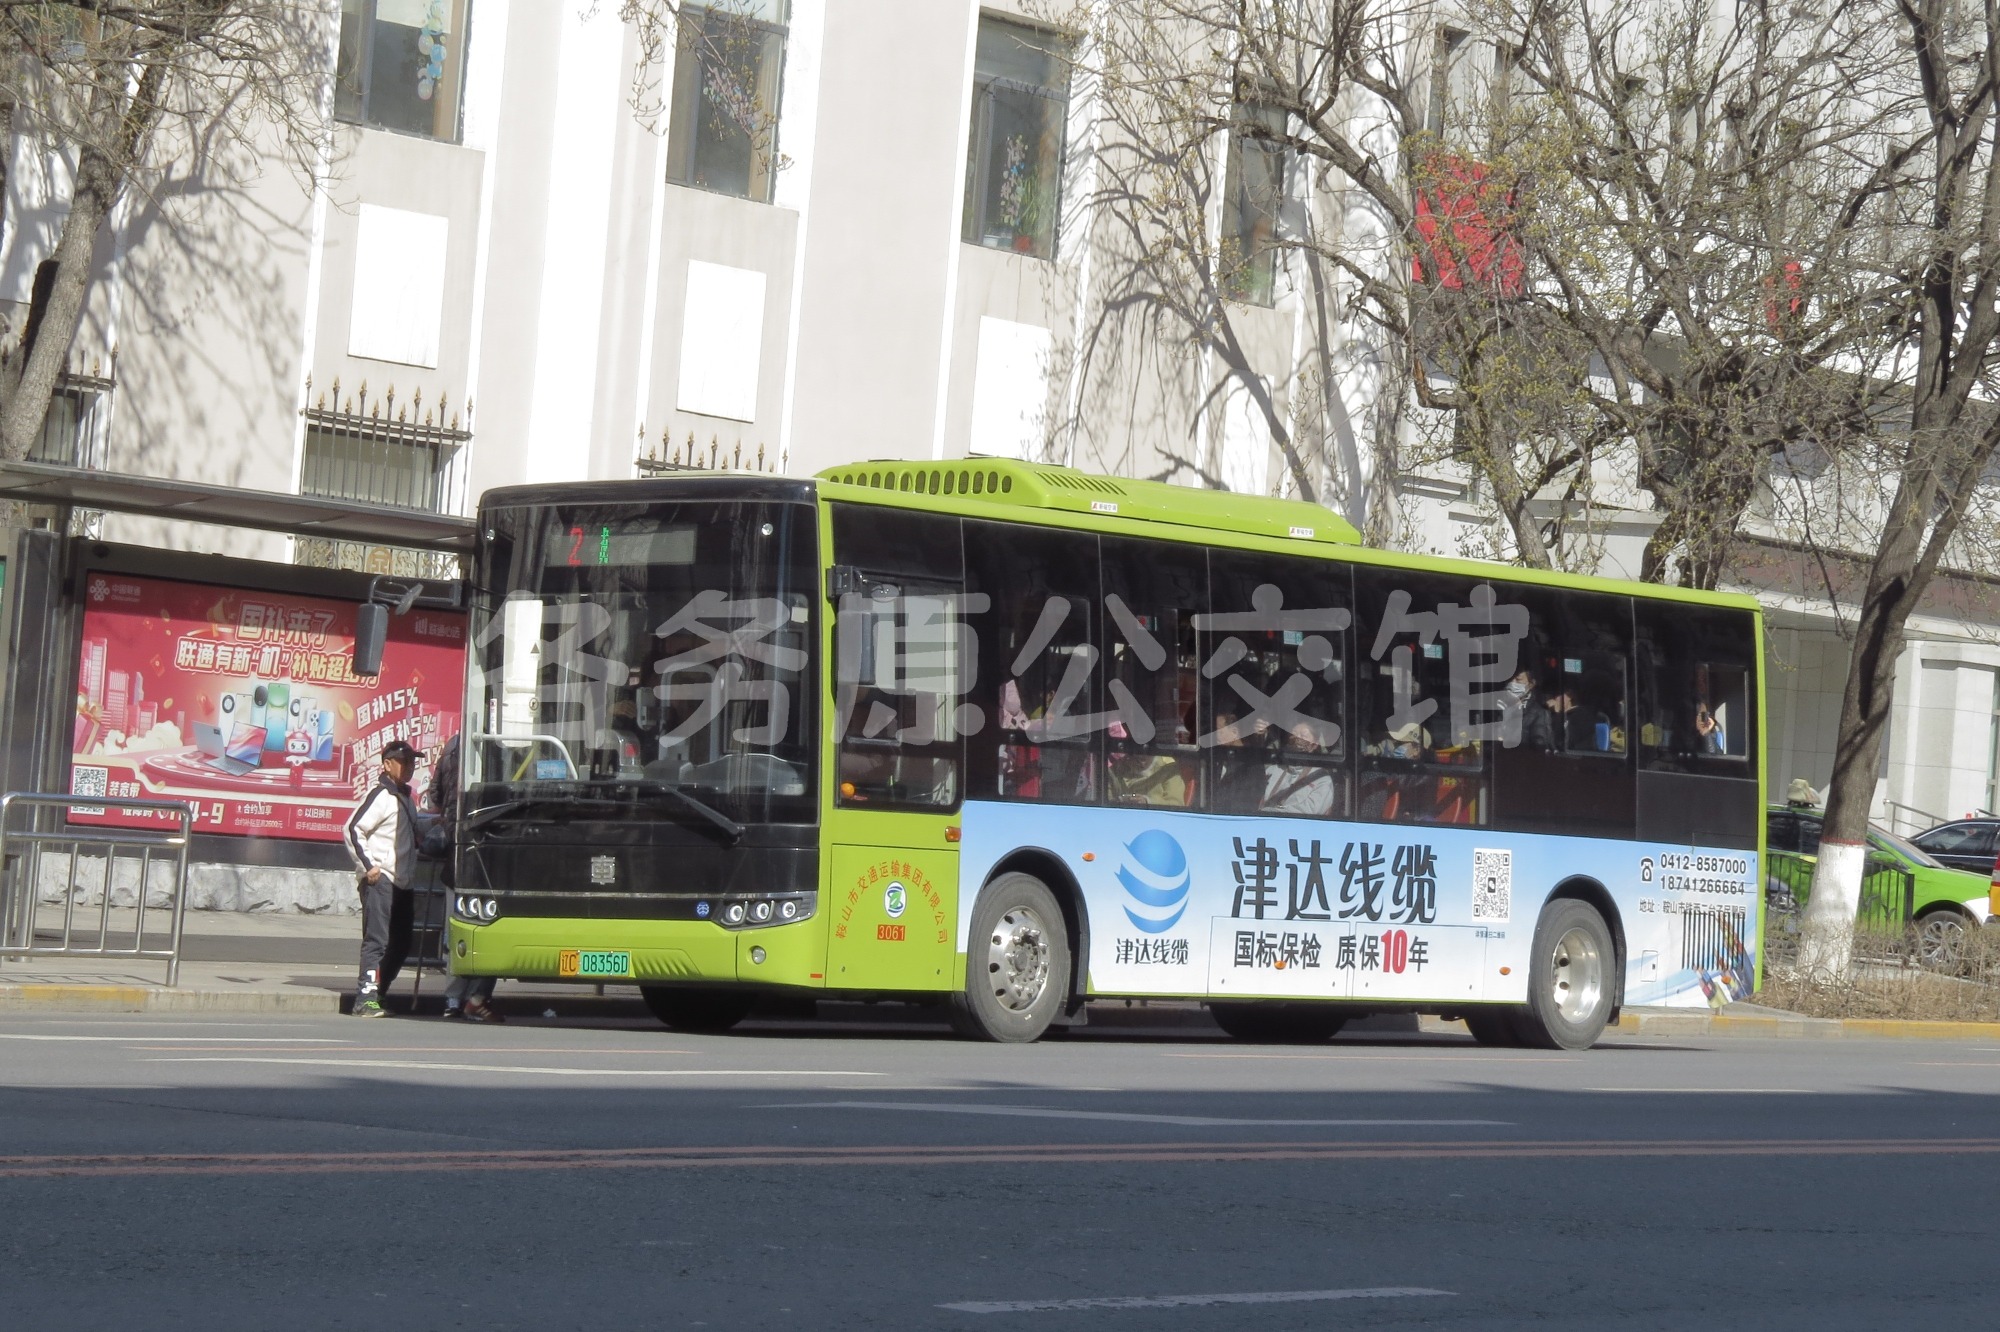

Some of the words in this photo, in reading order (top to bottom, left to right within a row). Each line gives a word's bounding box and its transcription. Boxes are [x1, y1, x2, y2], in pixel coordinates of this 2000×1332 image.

[567, 527, 583, 565] 2
[238, 603, 335, 646] 国补来了
[356, 686, 419, 730] 国补15%
[108, 781, 141, 797] 装宽带
[1230, 836, 1438, 924] 津达线缆
[1660, 853, 1747, 875] 0412-8587000
[1660, 875, 1745, 895] 18741266664
[835, 860, 948, 944] 鞍山市交通运输集团有限公司
[878, 925, 905, 940] 3061
[561, 953, 577, 973] 辽C
[582, 954, 628, 973] 08356D
[1115, 938, 1189, 965] 津达线缆
[1233, 930, 1321, 969] 国标保检
[1335, 928, 1429, 975] 质保10年
